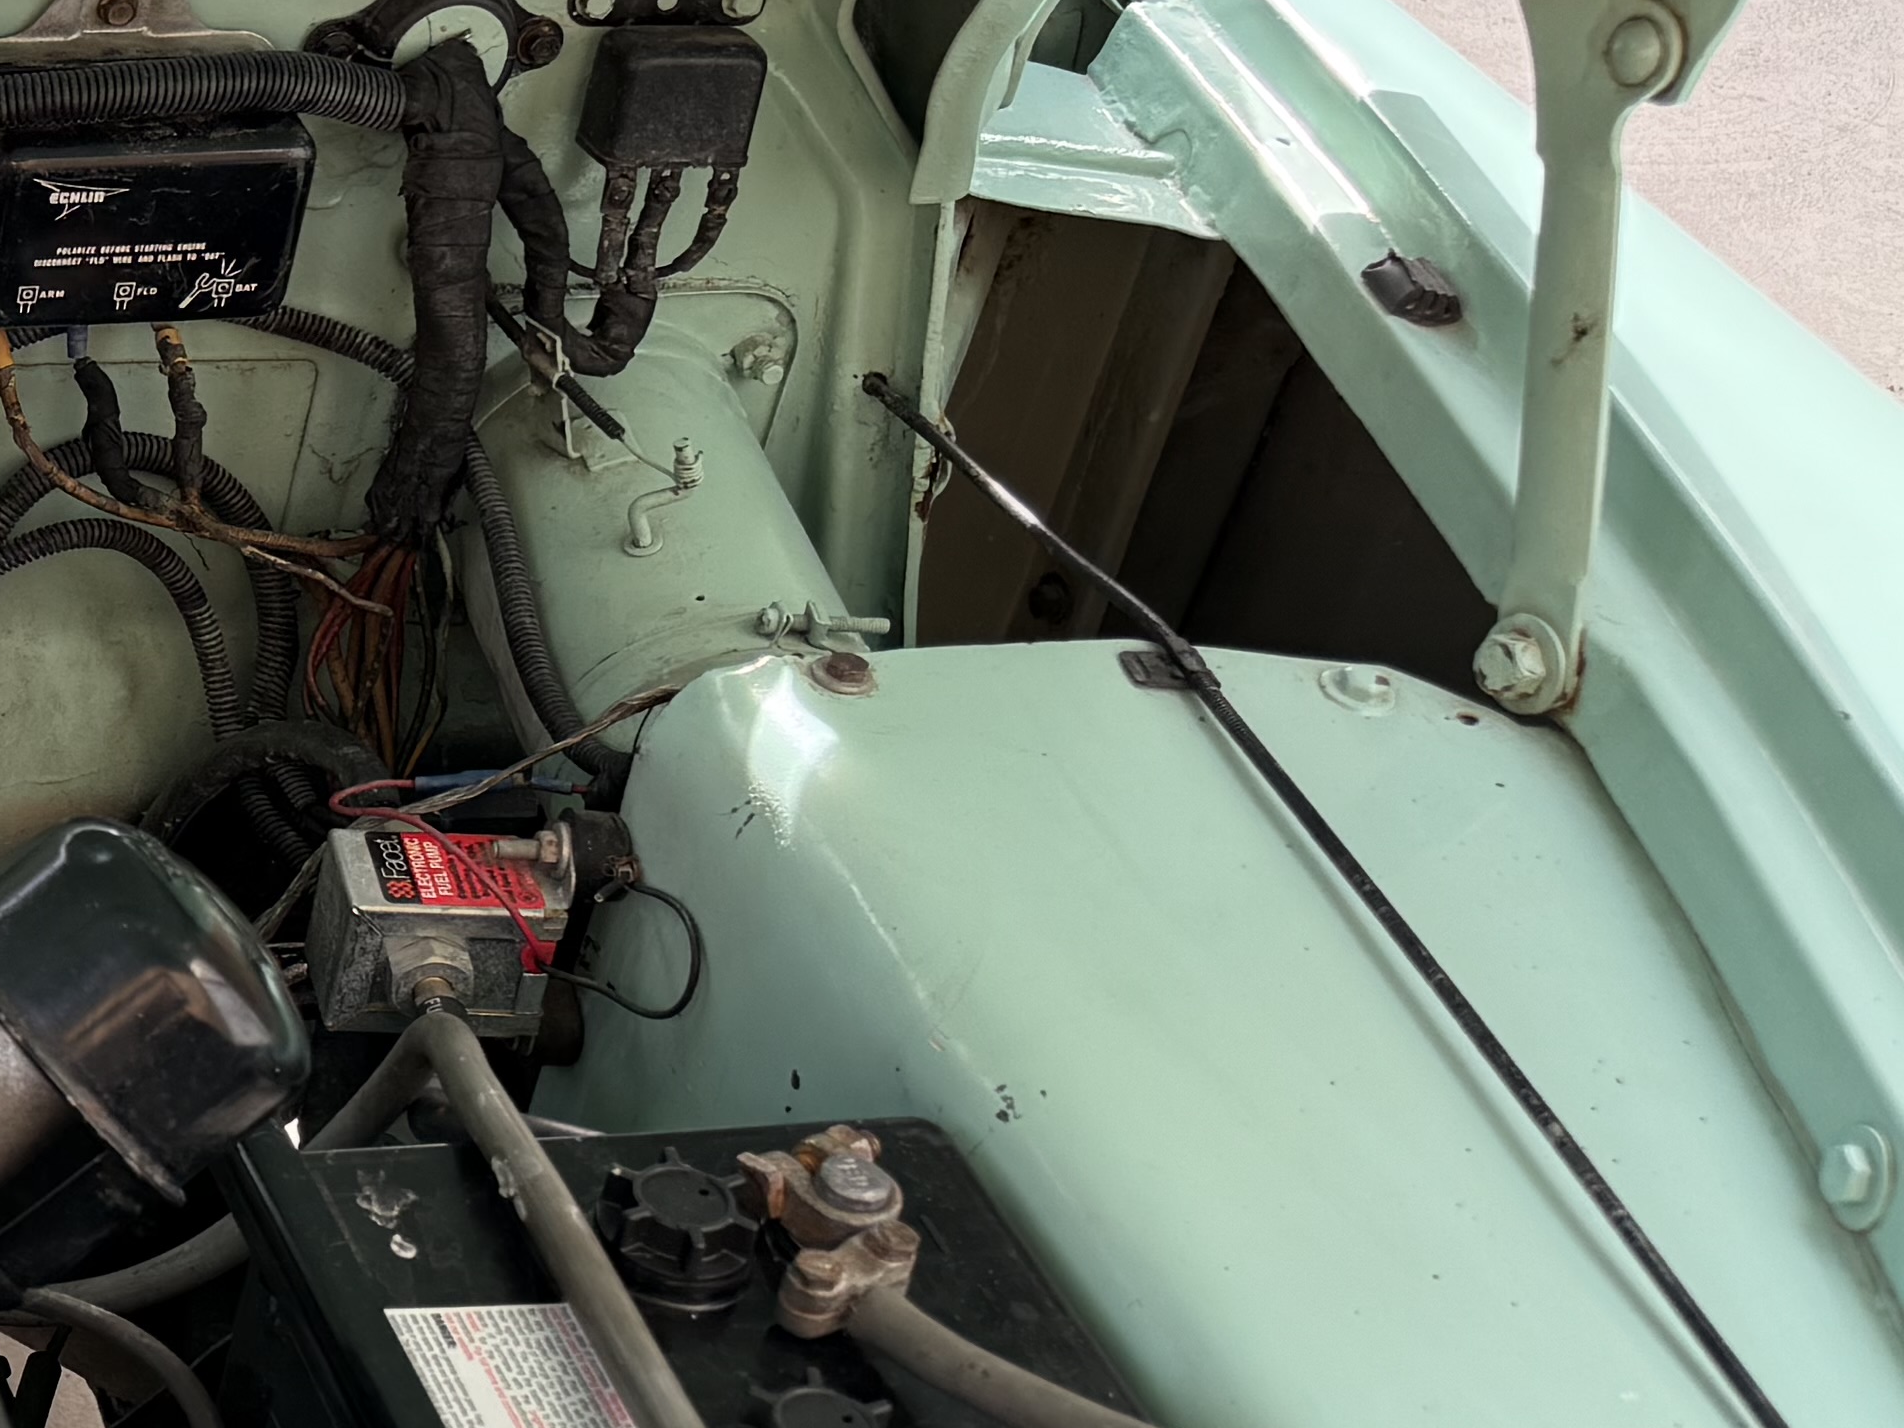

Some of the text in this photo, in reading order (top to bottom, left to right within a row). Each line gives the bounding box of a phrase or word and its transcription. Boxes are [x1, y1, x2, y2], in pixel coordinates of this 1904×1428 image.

[56, 242, 206, 256] POLARIZE BEFORE STARTING ENGINE
[33, 256, 82, 267] DISCONNECT
[39, 289, 65, 298] ARM
[136, 286, 158, 296] FLD
[234, 283, 258, 292] BAT
[373, 838, 406, 880] Facet
[404, 837, 437, 899] ELECTRONIC
[422, 841, 454, 897] FUEL PUMP
